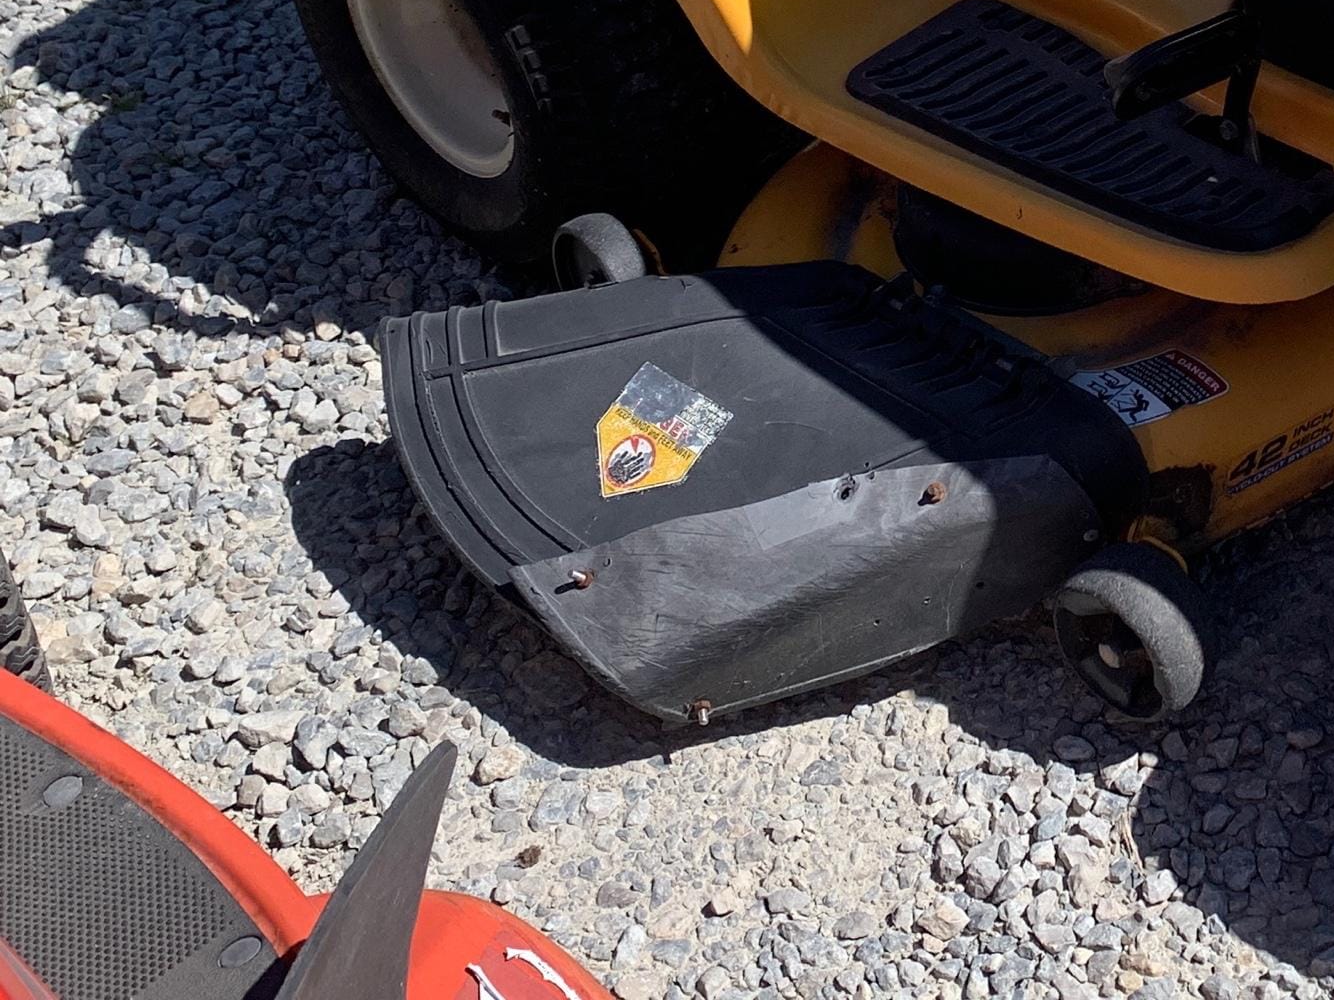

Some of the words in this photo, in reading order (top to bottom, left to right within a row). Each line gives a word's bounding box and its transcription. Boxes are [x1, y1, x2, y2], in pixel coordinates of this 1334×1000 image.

[1178, 358, 1219, 391] DANGER
[630, 416, 650, 432] HANDS
[1287, 422, 1333, 451] DECK
[1227, 433, 1288, 481] 42
[1292, 407, 1334, 438] INCH
